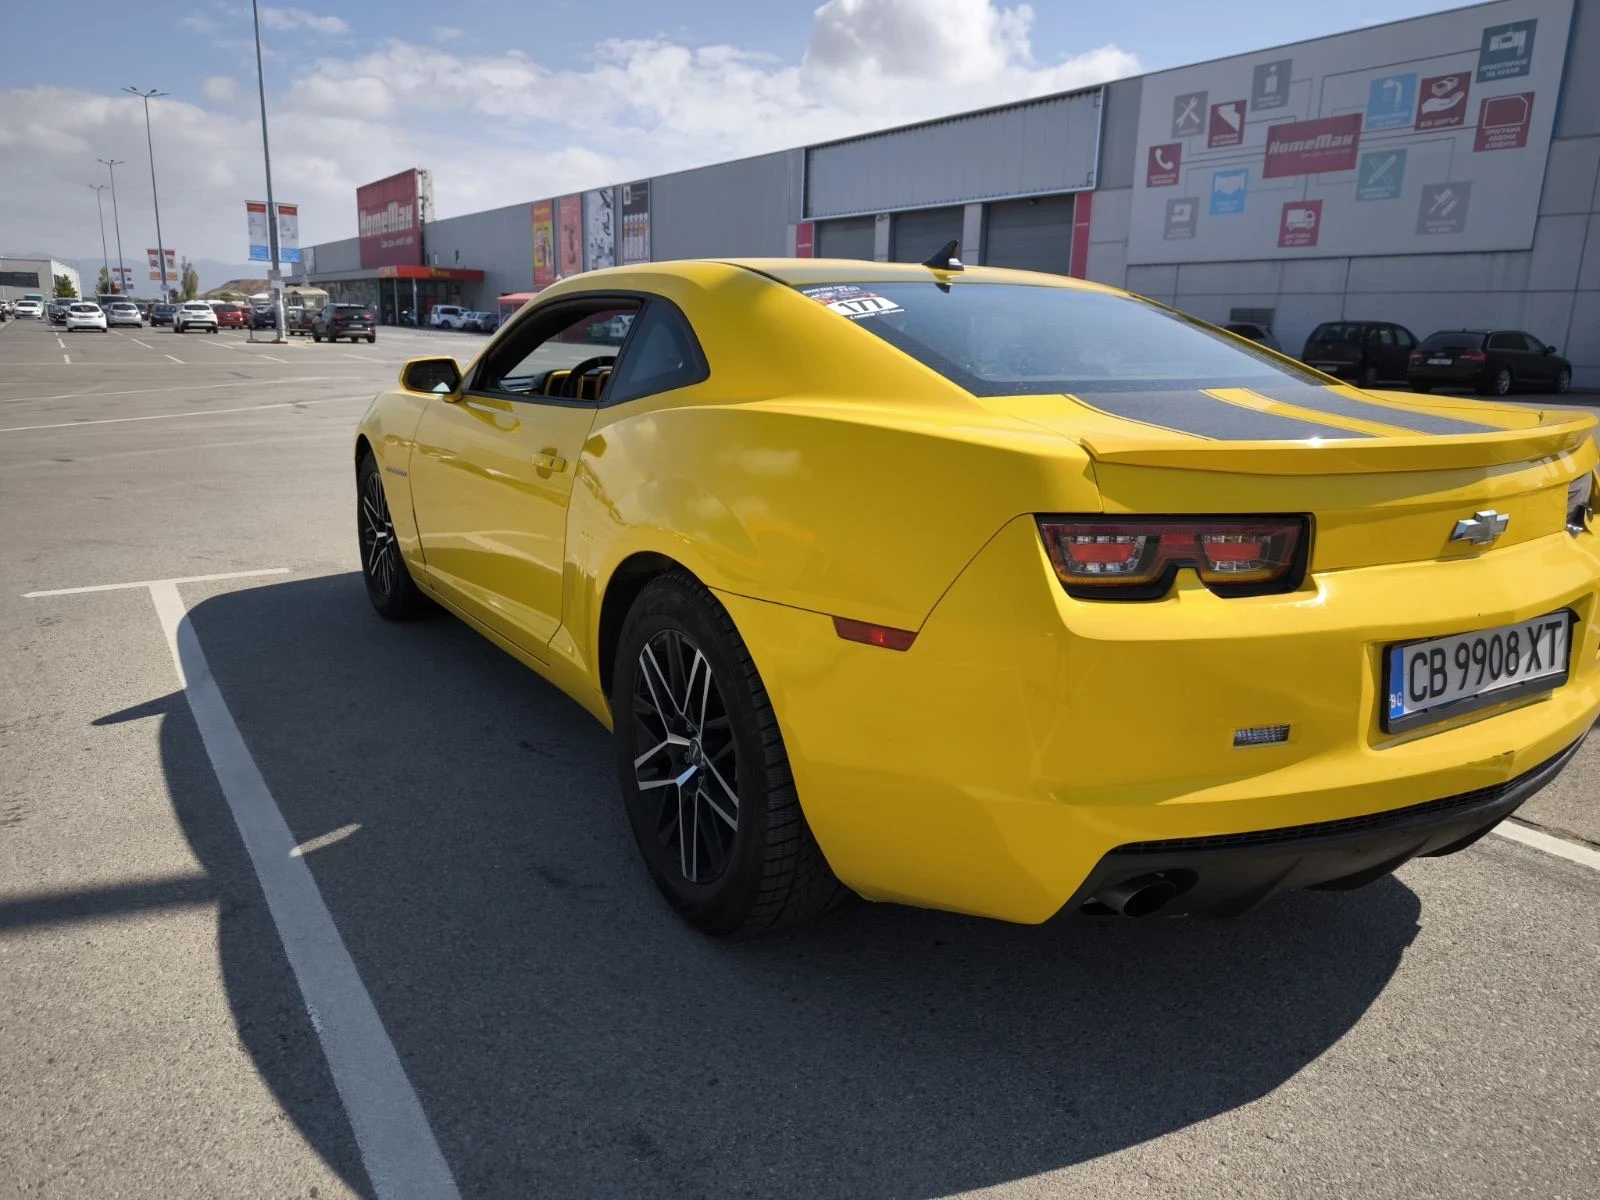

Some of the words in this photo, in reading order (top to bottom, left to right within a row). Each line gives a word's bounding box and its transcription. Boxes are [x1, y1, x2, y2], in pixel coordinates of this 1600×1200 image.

[838, 298, 883, 313] 177
[1409, 648, 1448, 702] CB
[1455, 630, 1520, 690] 9908
[1525, 620, 1563, 673] XT
[1390, 692, 1403, 708] BG
